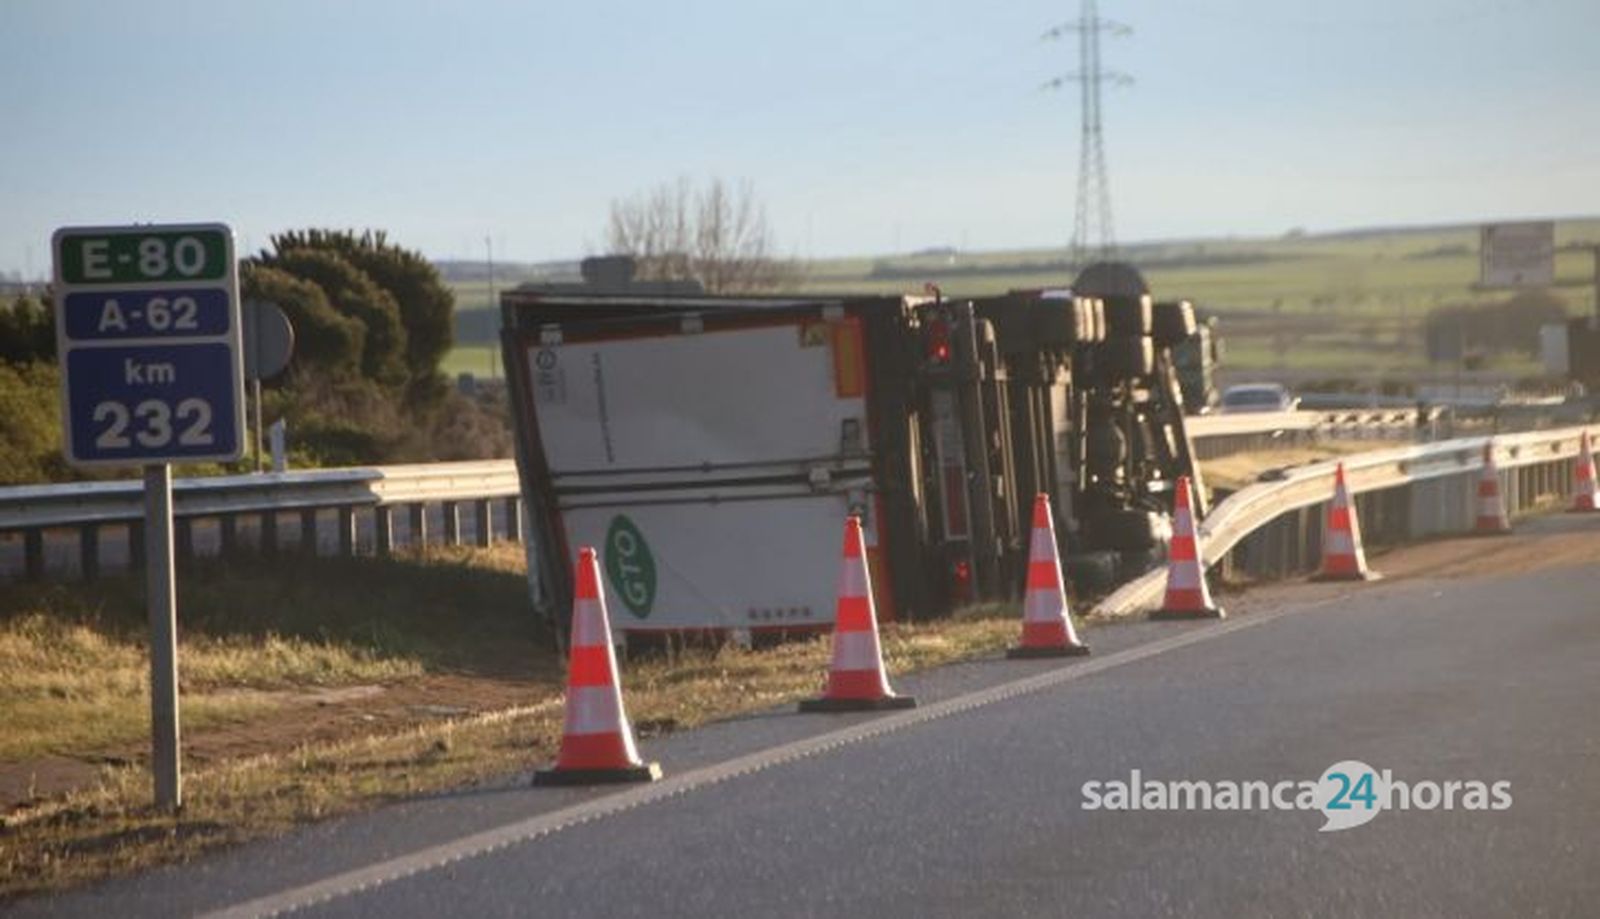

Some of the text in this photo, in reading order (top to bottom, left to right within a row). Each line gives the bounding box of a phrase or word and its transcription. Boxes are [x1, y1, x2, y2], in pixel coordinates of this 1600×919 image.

[82, 237, 206, 278] E-80
[98, 297, 199, 332] A-62
[124, 358, 176, 385] km
[92, 398, 214, 449] 232
[614, 530, 648, 606] GTO
